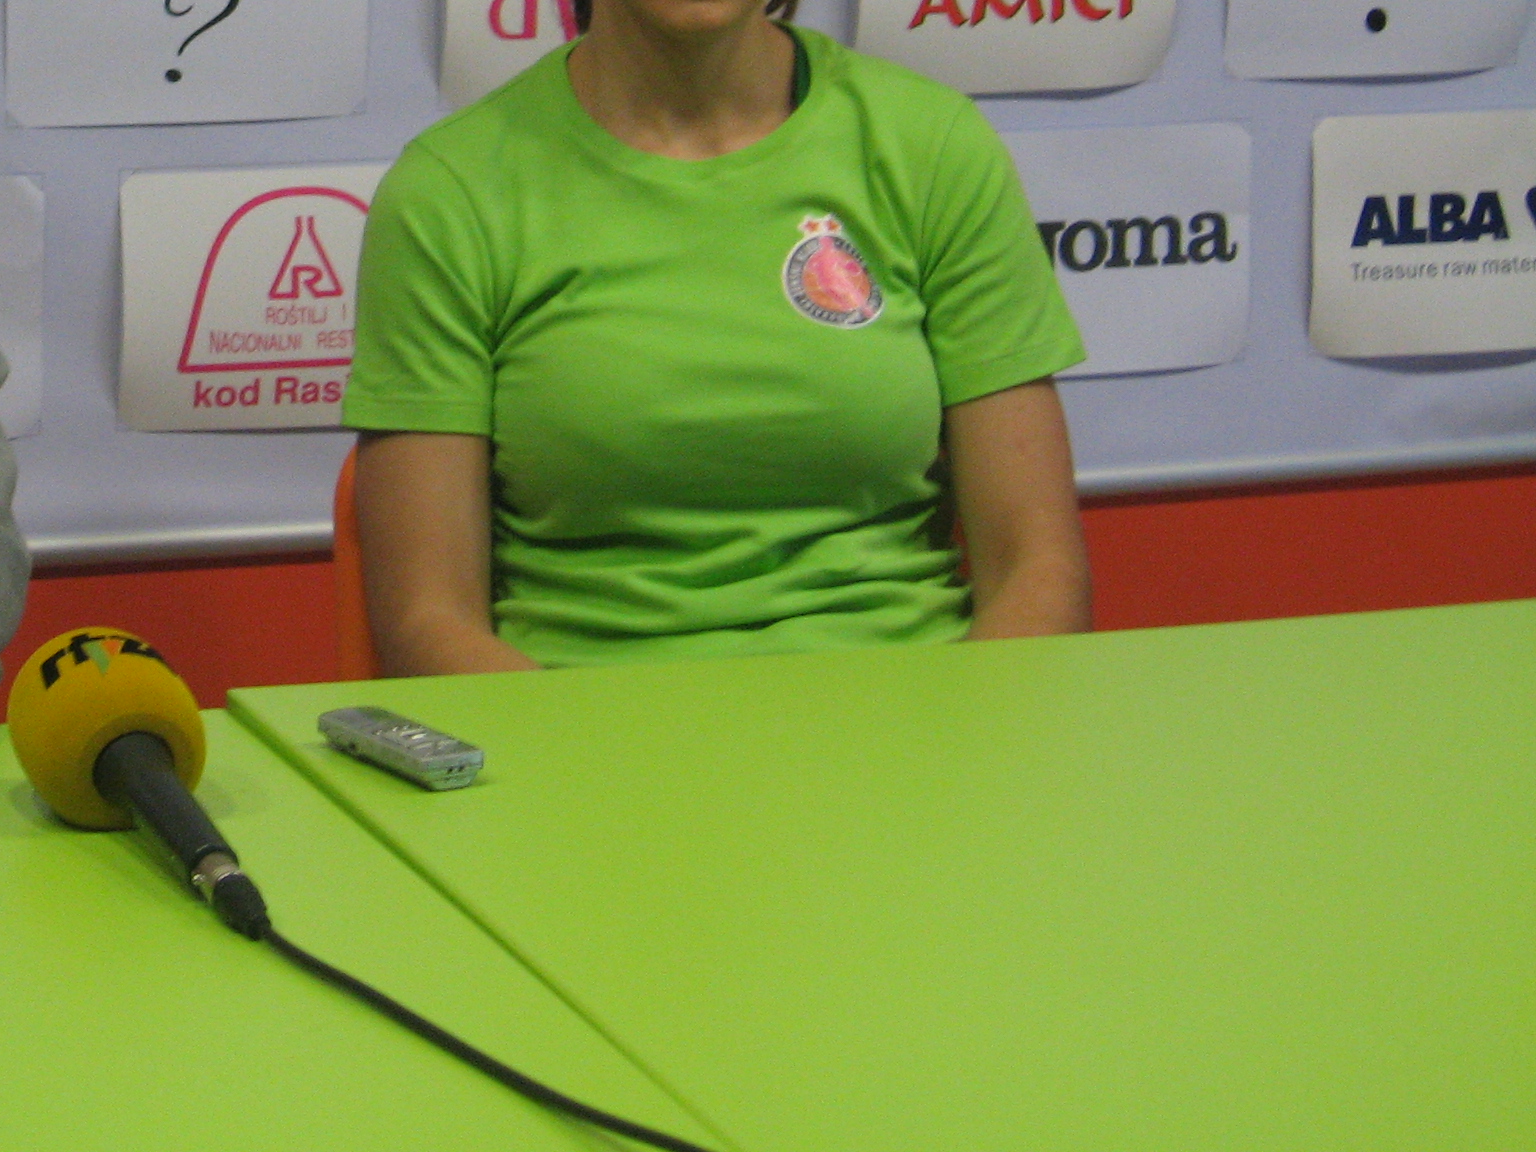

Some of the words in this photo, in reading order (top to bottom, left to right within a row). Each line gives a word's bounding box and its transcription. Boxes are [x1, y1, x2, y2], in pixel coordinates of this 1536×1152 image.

[1351, 190, 1511, 248] ALBA
[1352, 261, 1438, 281] Treasure
[1443, 260, 1477, 277] raw
[193, 379, 260, 409] kod
